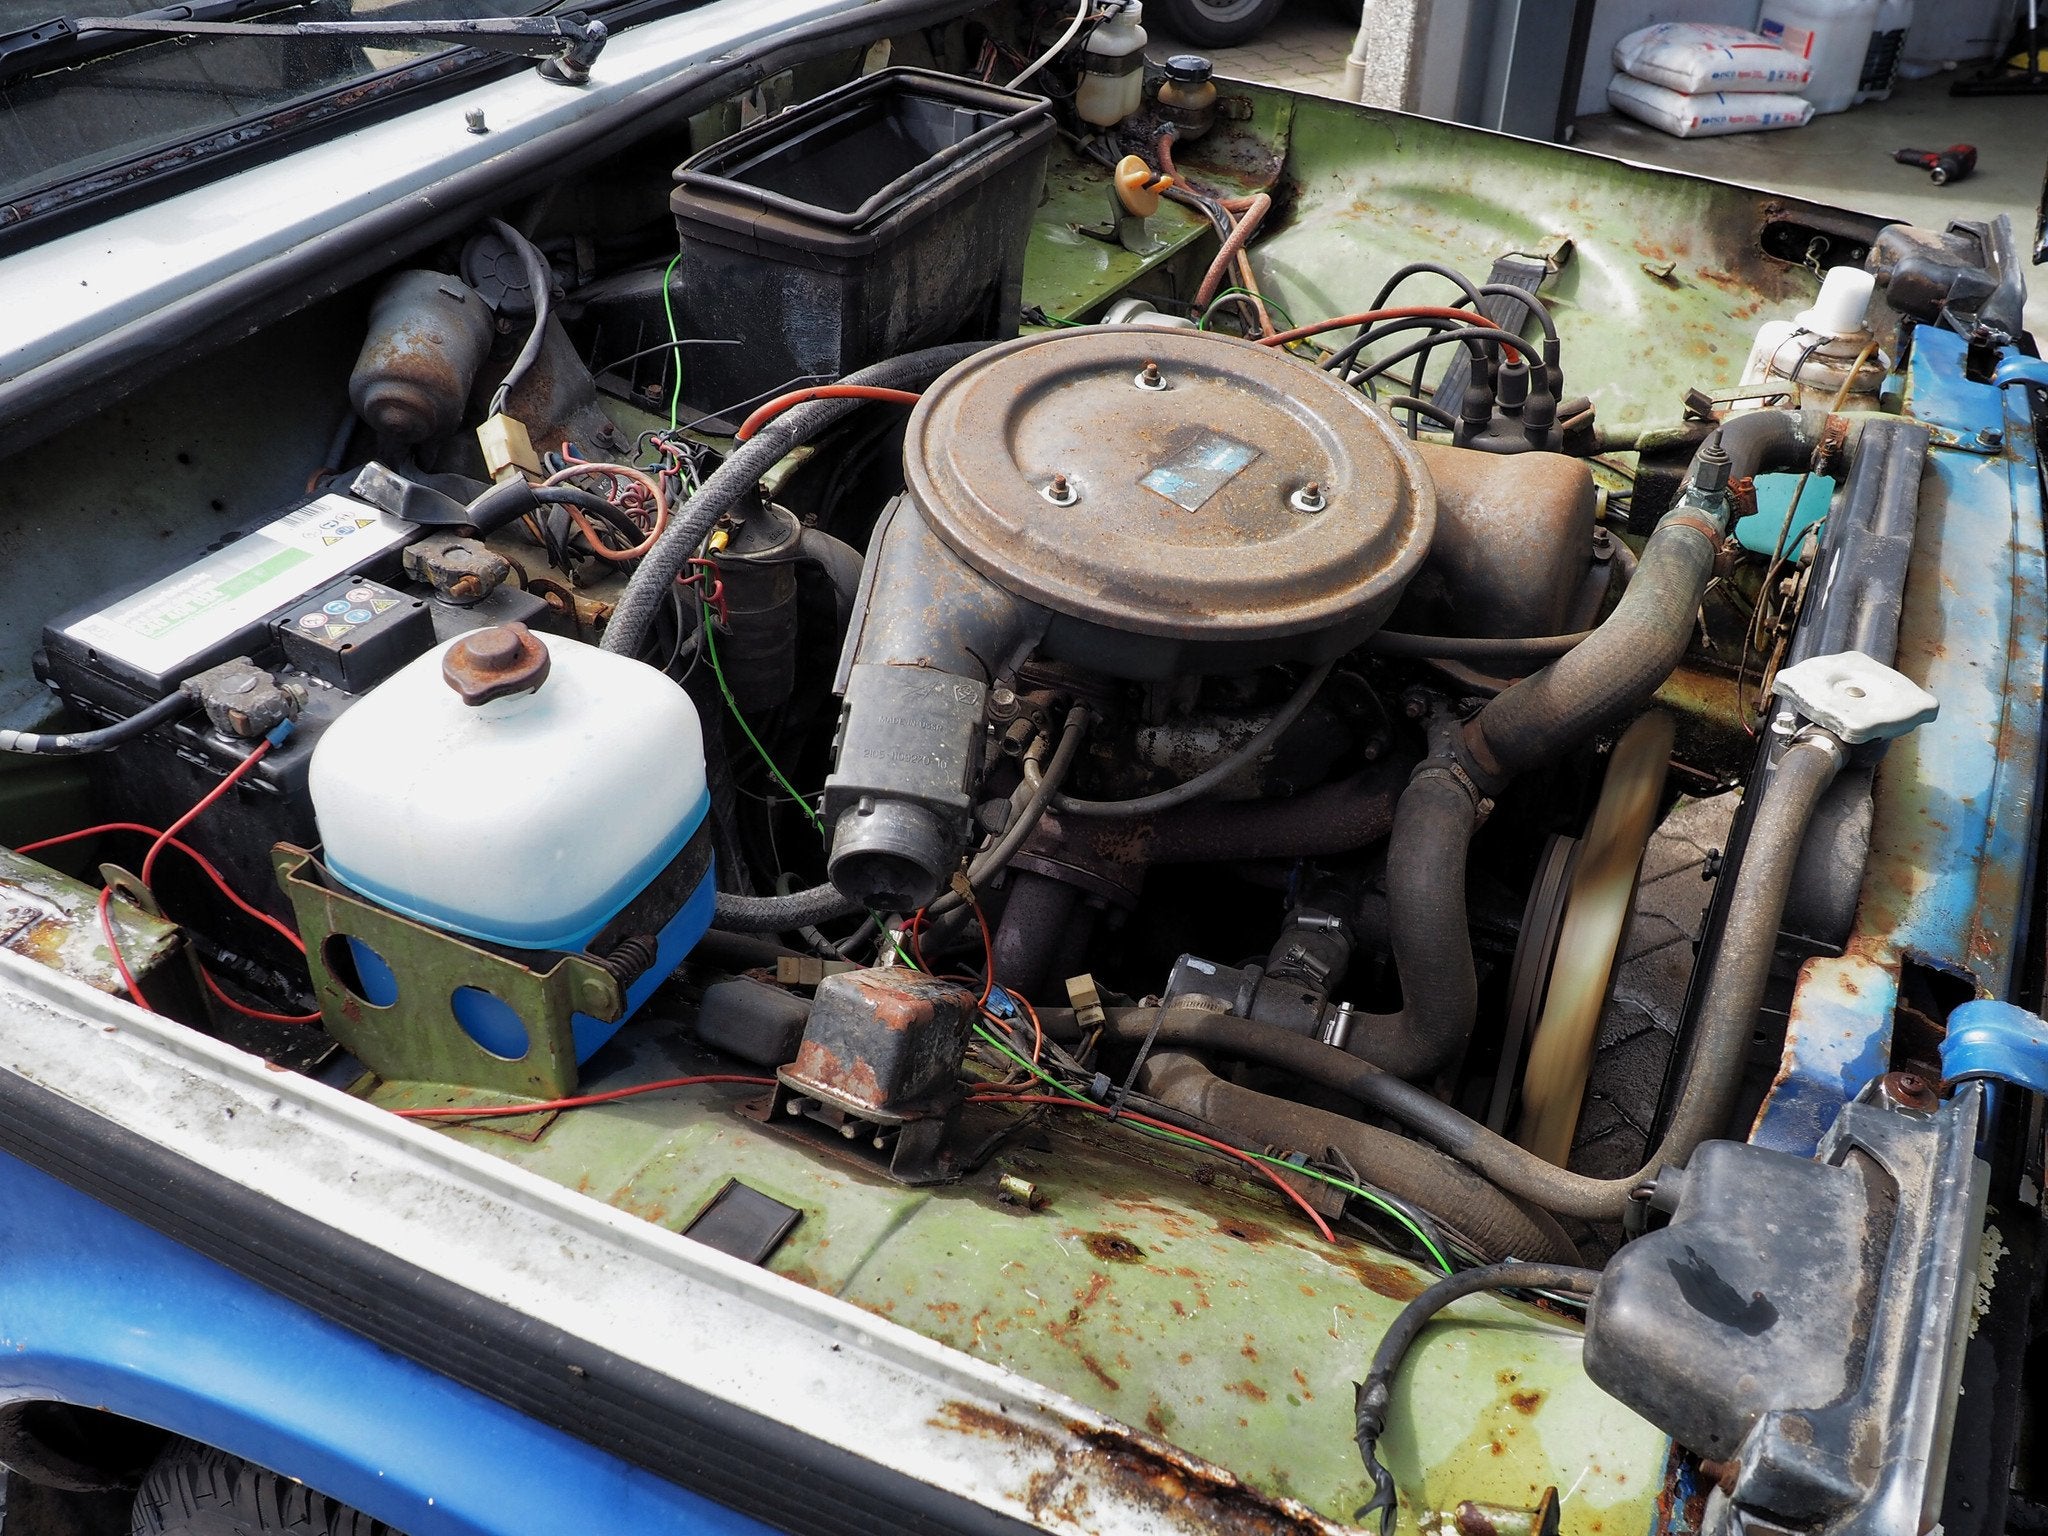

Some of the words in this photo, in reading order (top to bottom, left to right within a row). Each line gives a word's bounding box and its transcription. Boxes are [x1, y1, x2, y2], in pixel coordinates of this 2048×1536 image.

[879, 716, 906, 727] MADE
[907, 718, 918, 728] IN
[920, 721, 943, 731] USSR
